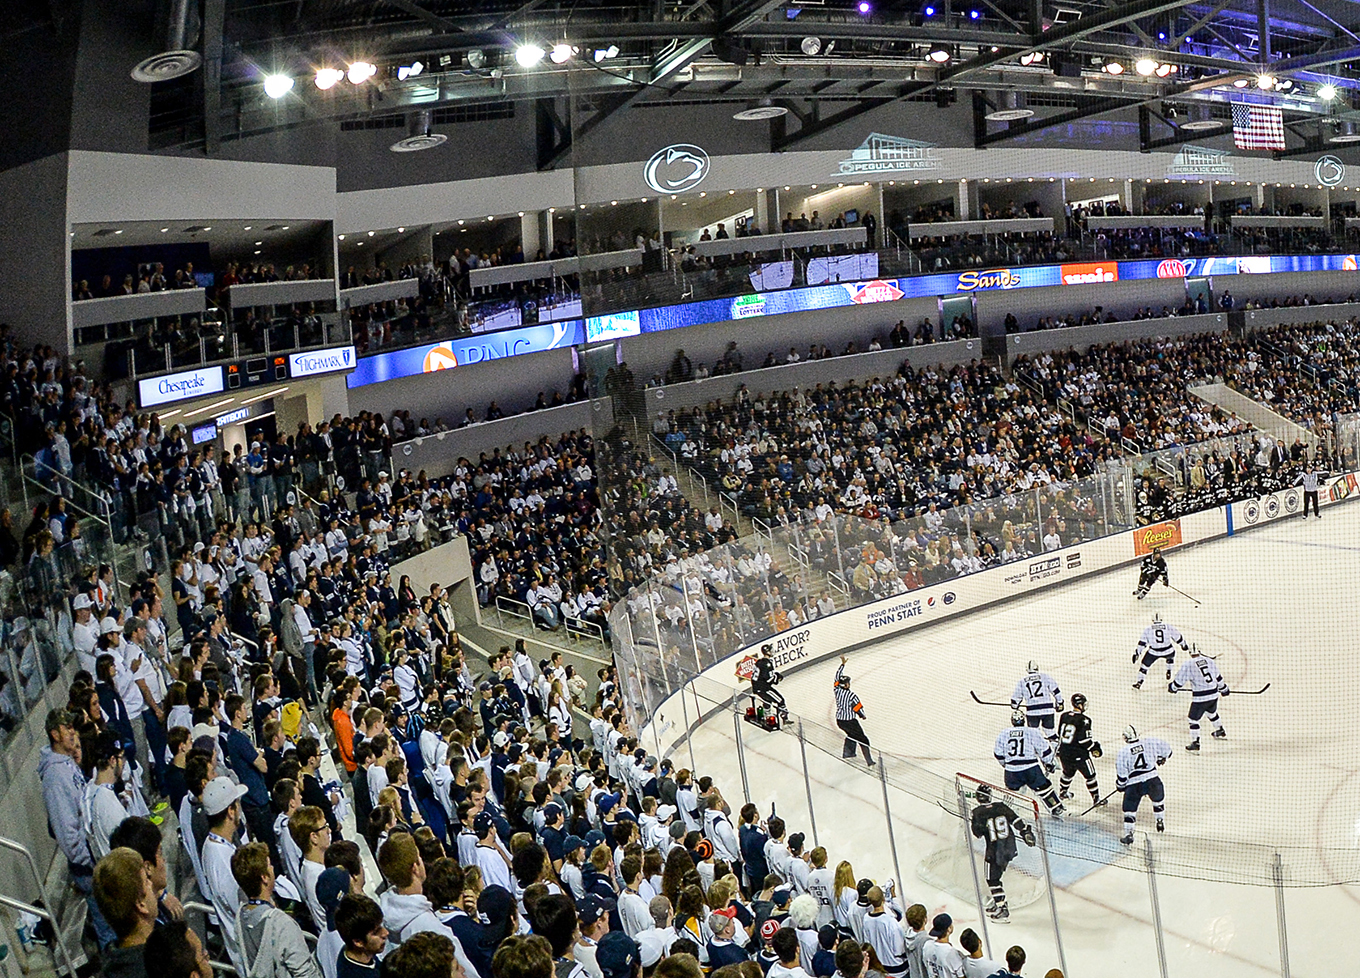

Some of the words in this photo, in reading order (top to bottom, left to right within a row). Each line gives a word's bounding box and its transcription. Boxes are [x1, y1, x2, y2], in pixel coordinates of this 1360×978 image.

[855, 162, 894, 171] PEGULA
[957, 269, 1022, 291] Sands
[299, 353, 343, 372] HIGHMARK
[158, 373, 206, 395] Chesapeake
[216, 407, 250, 427] ZAMBONI
[867, 608, 887, 620] PROUD
[888, 602, 912, 614] PARTNER
[868, 614, 895, 630] PENN
[897, 606, 922, 621] STATE
[1155, 629, 1164, 643] 9
[772, 646, 808, 668] HECK.
[1200, 666, 1213, 684] 5
[1026, 680, 1044, 699] 12
[1060, 724, 1077, 744] 13
[1008, 738, 1025, 758] 31
[1134, 753, 1149, 770] 4
[986, 815, 1010, 842] 19
